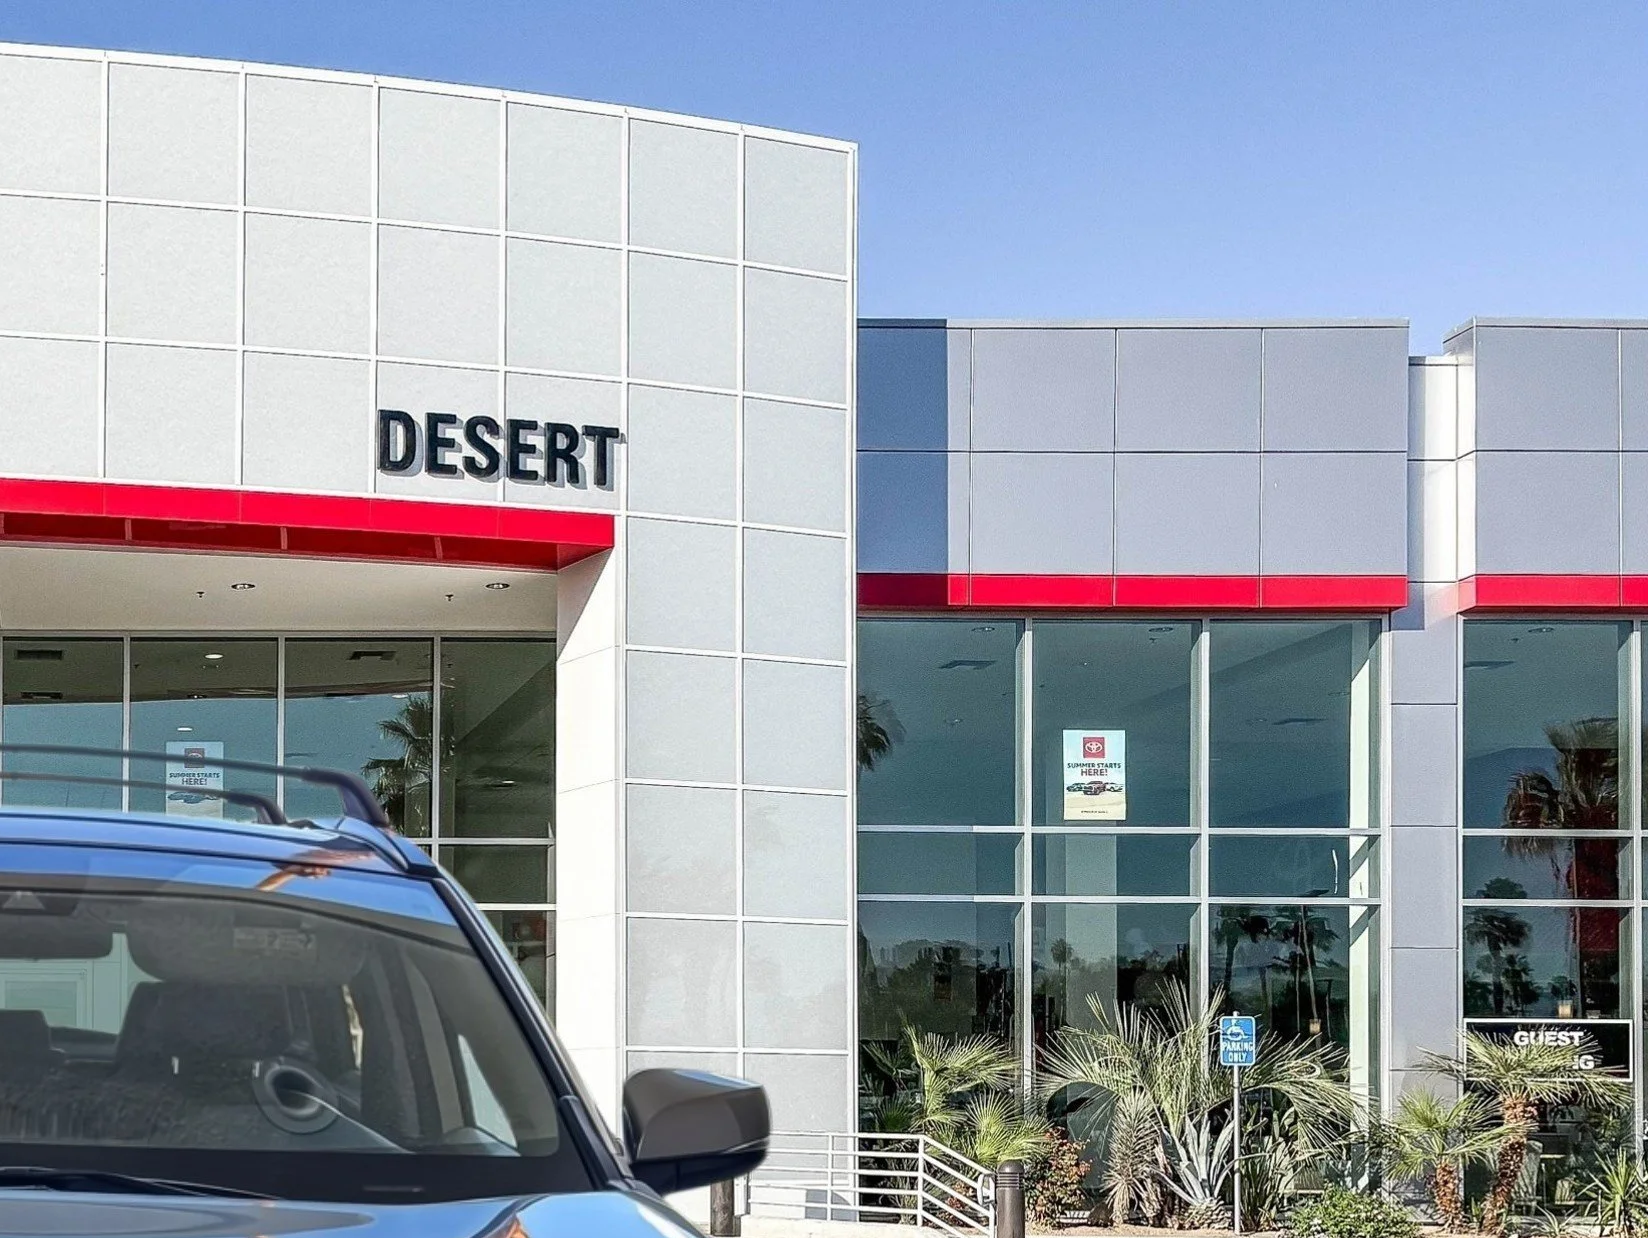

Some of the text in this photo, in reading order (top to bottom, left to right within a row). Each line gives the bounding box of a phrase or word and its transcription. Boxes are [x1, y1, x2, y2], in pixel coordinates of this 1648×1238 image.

[376, 408, 621, 487] DESERT
[1080, 768, 1108, 777] HERE!
[181, 777, 208, 786] HERE!
[1513, 1030, 1584, 1047] GUEST
[1222, 1040, 1253, 1052] PARKING
[1228, 1051, 1248, 1062] ONLY
